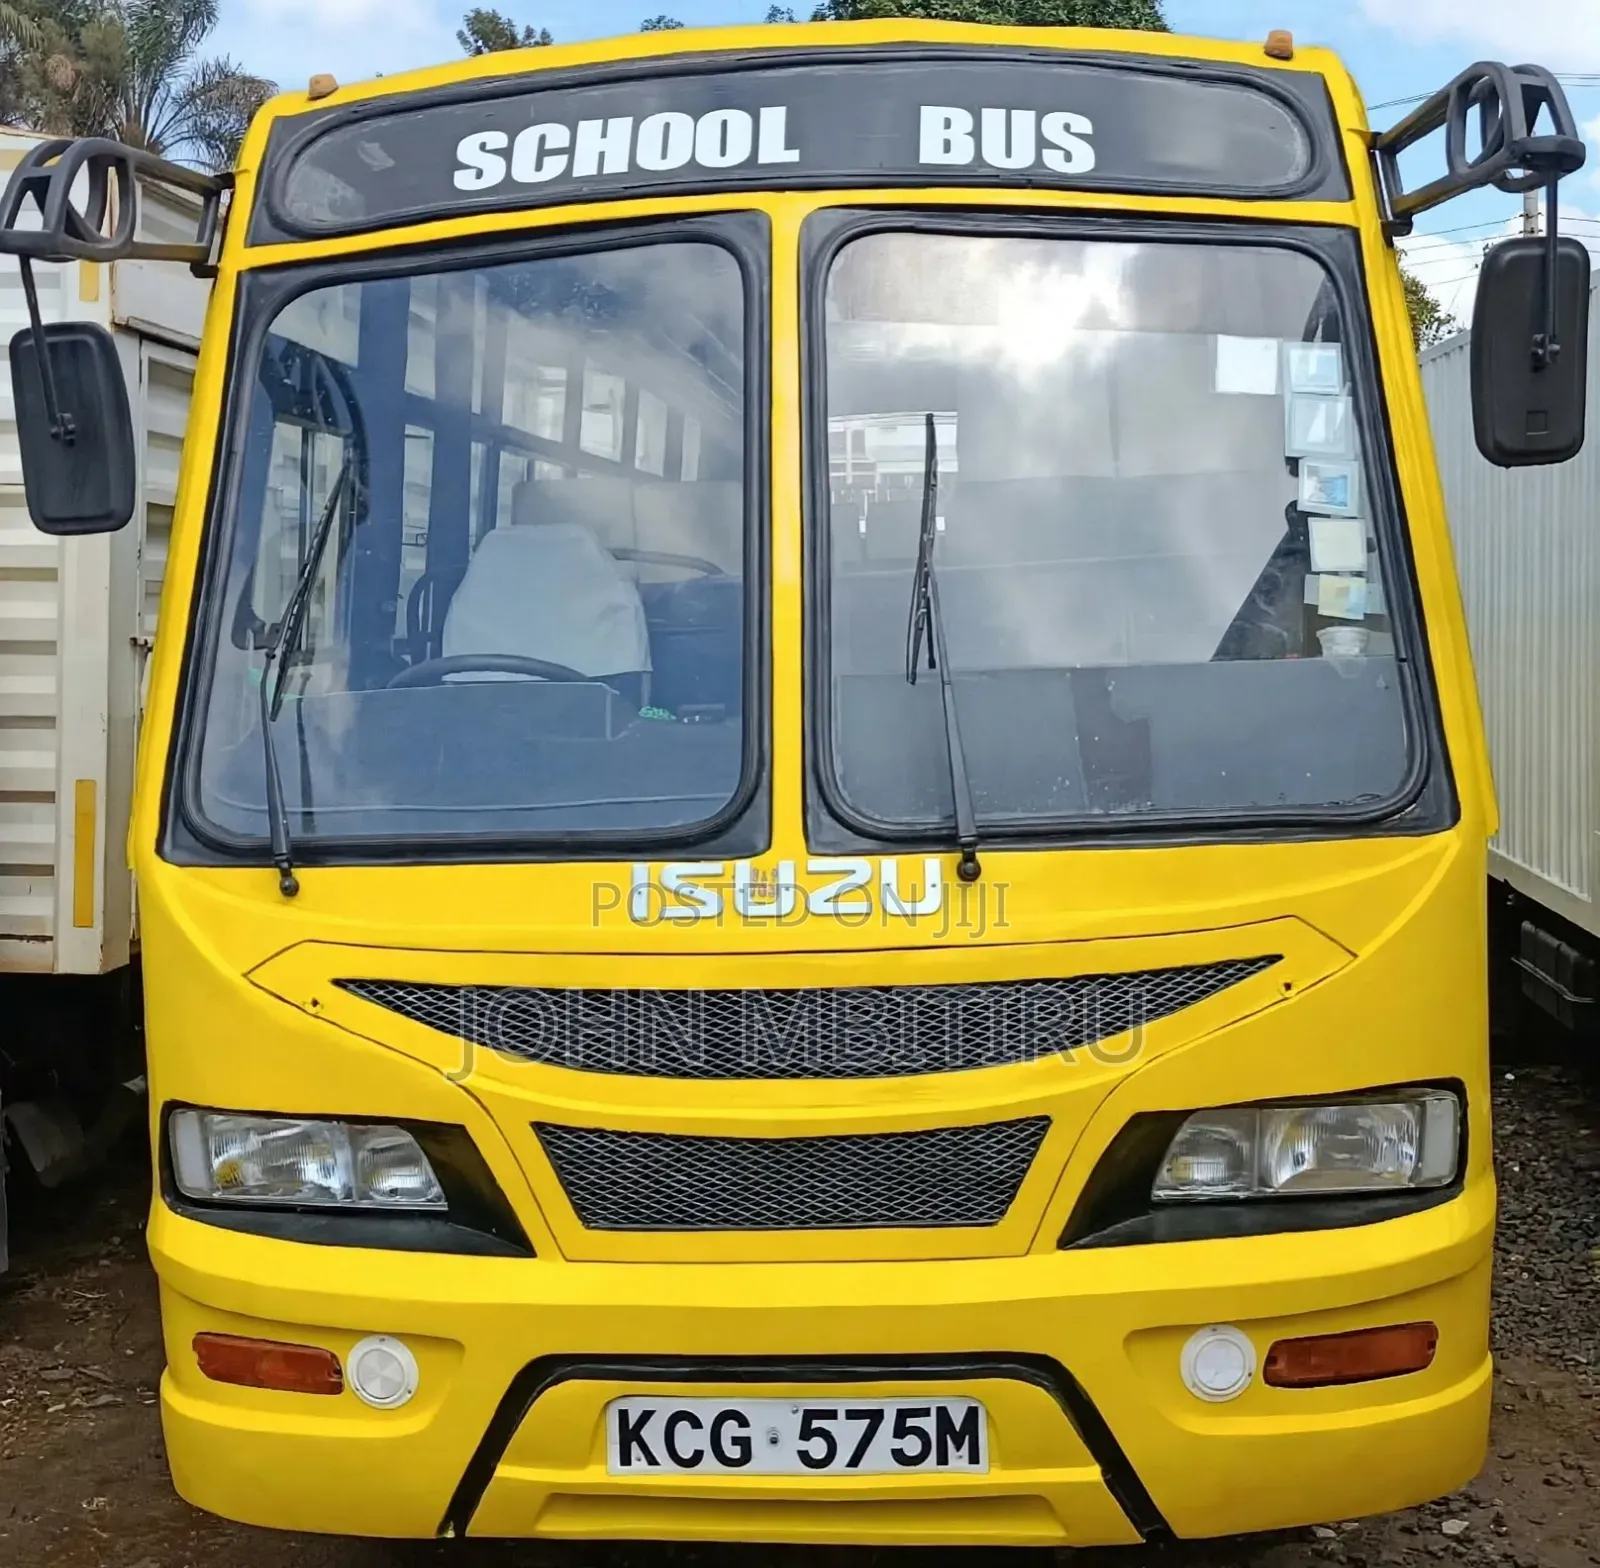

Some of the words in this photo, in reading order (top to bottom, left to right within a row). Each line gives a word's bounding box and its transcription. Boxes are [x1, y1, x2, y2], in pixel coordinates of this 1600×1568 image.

[453, 105, 800, 191] SCHOOL
[918, 104, 1096, 174] BUS
[631, 858, 943, 922] ISUZU
[617, 1408, 753, 1469] KCG
[796, 1406, 981, 1470] 575M
